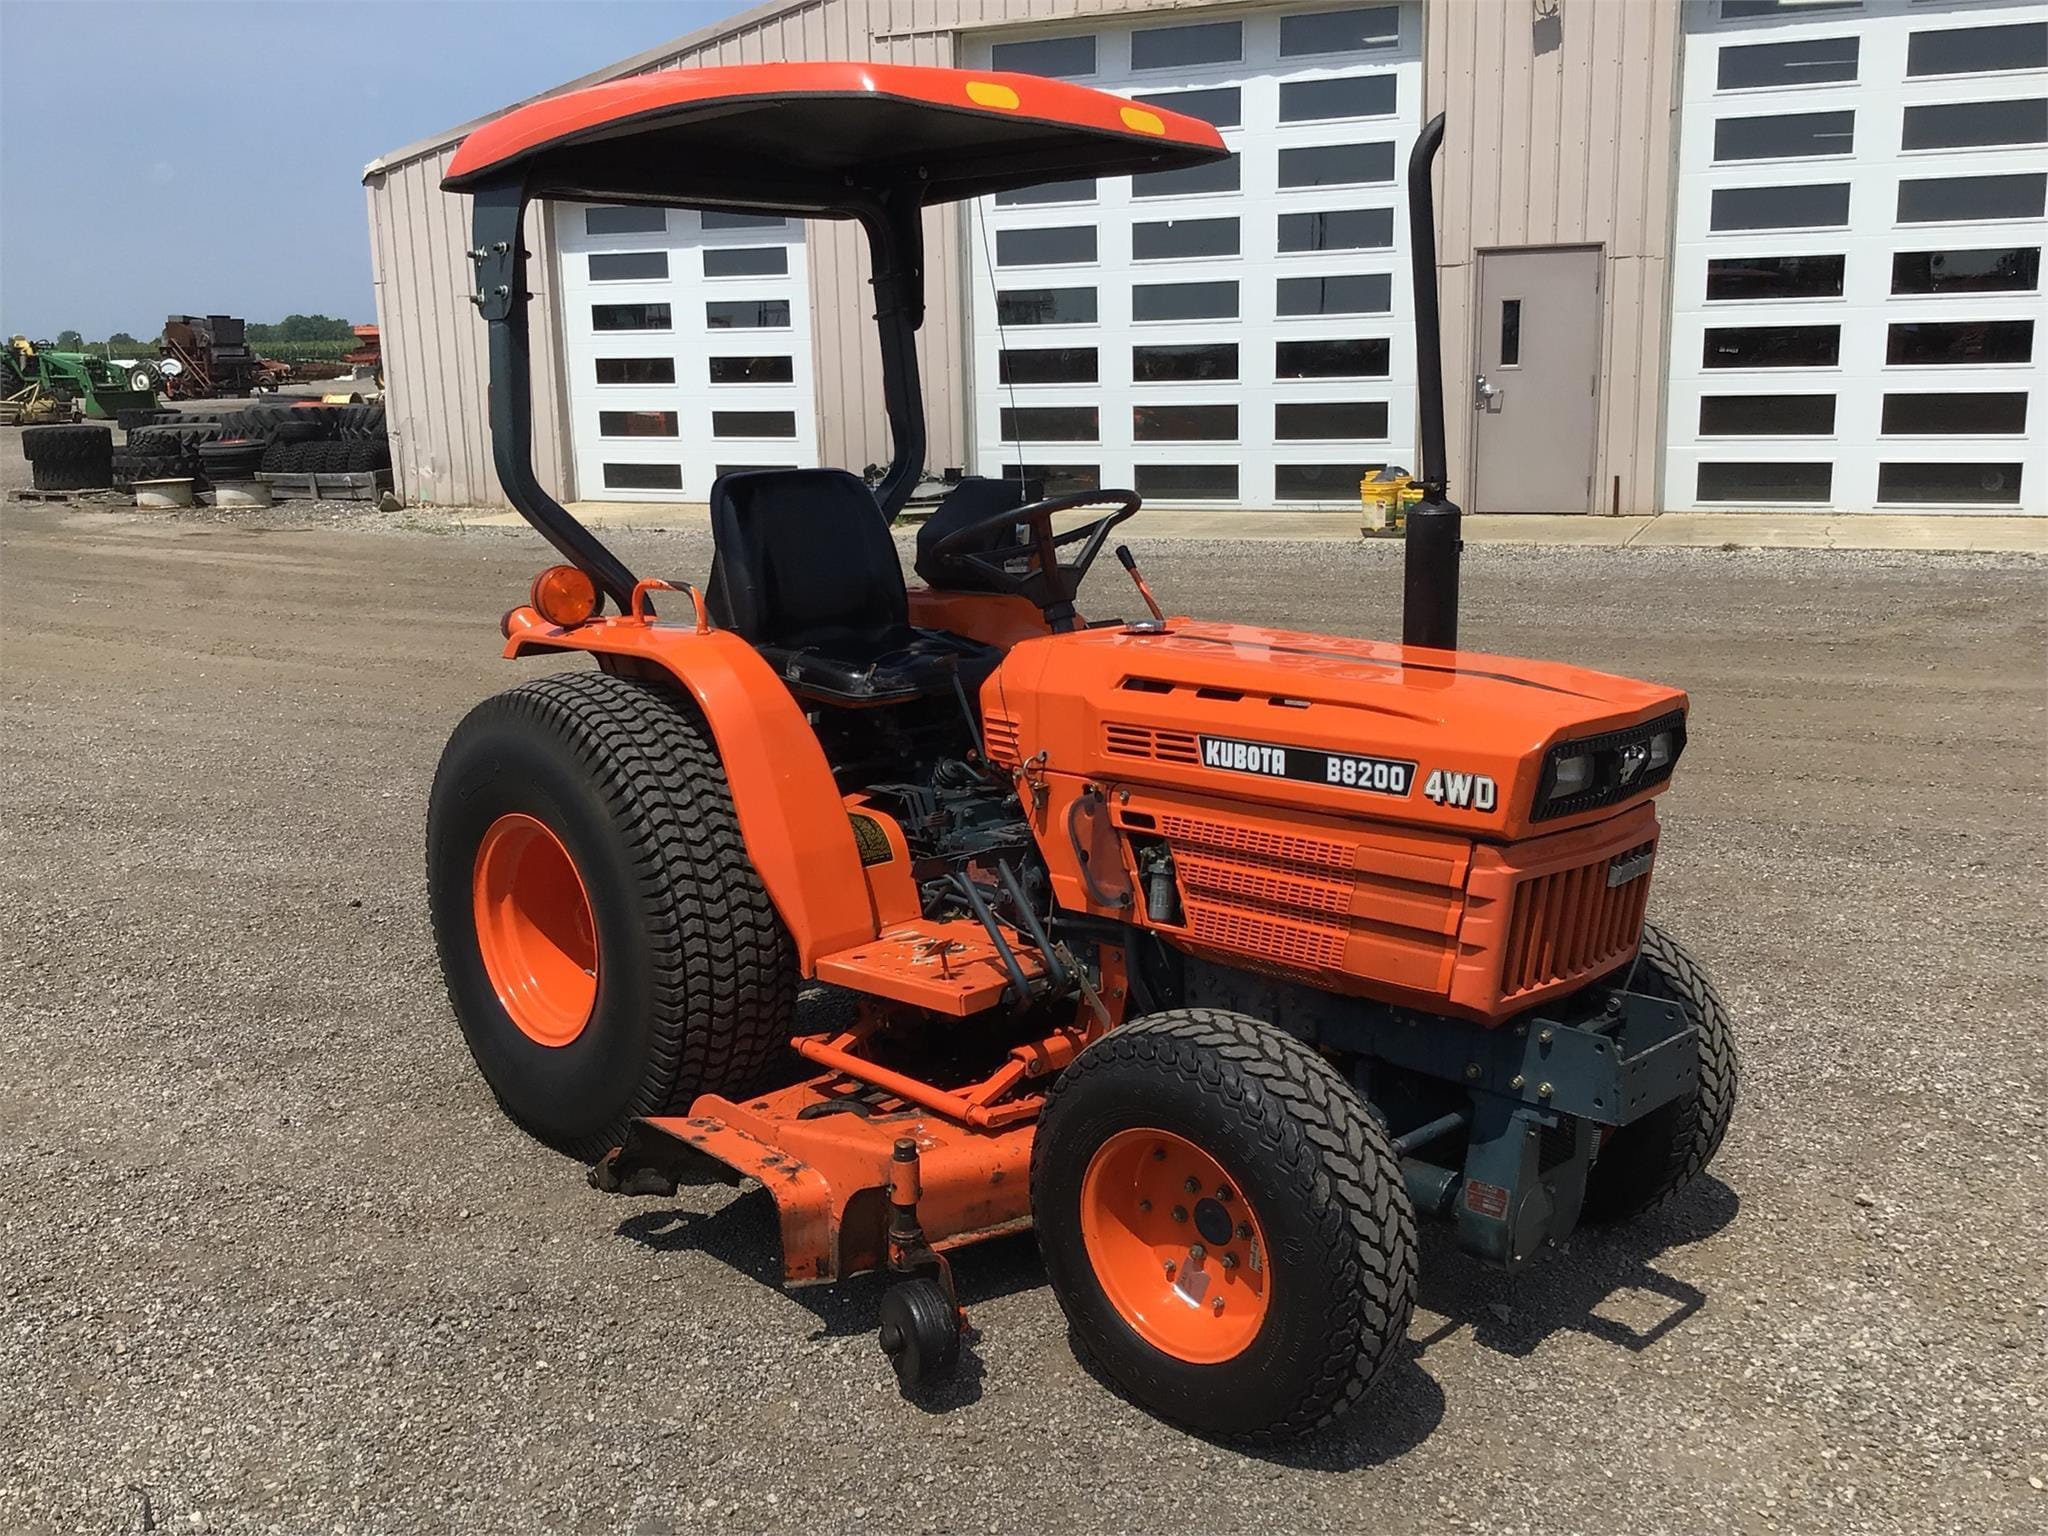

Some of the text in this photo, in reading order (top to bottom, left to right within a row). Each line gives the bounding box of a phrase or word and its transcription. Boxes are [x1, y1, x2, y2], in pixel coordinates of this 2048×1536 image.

[1206, 739, 1405, 792] KUBOTA B8200
[1424, 769, 1496, 812] 4WD
